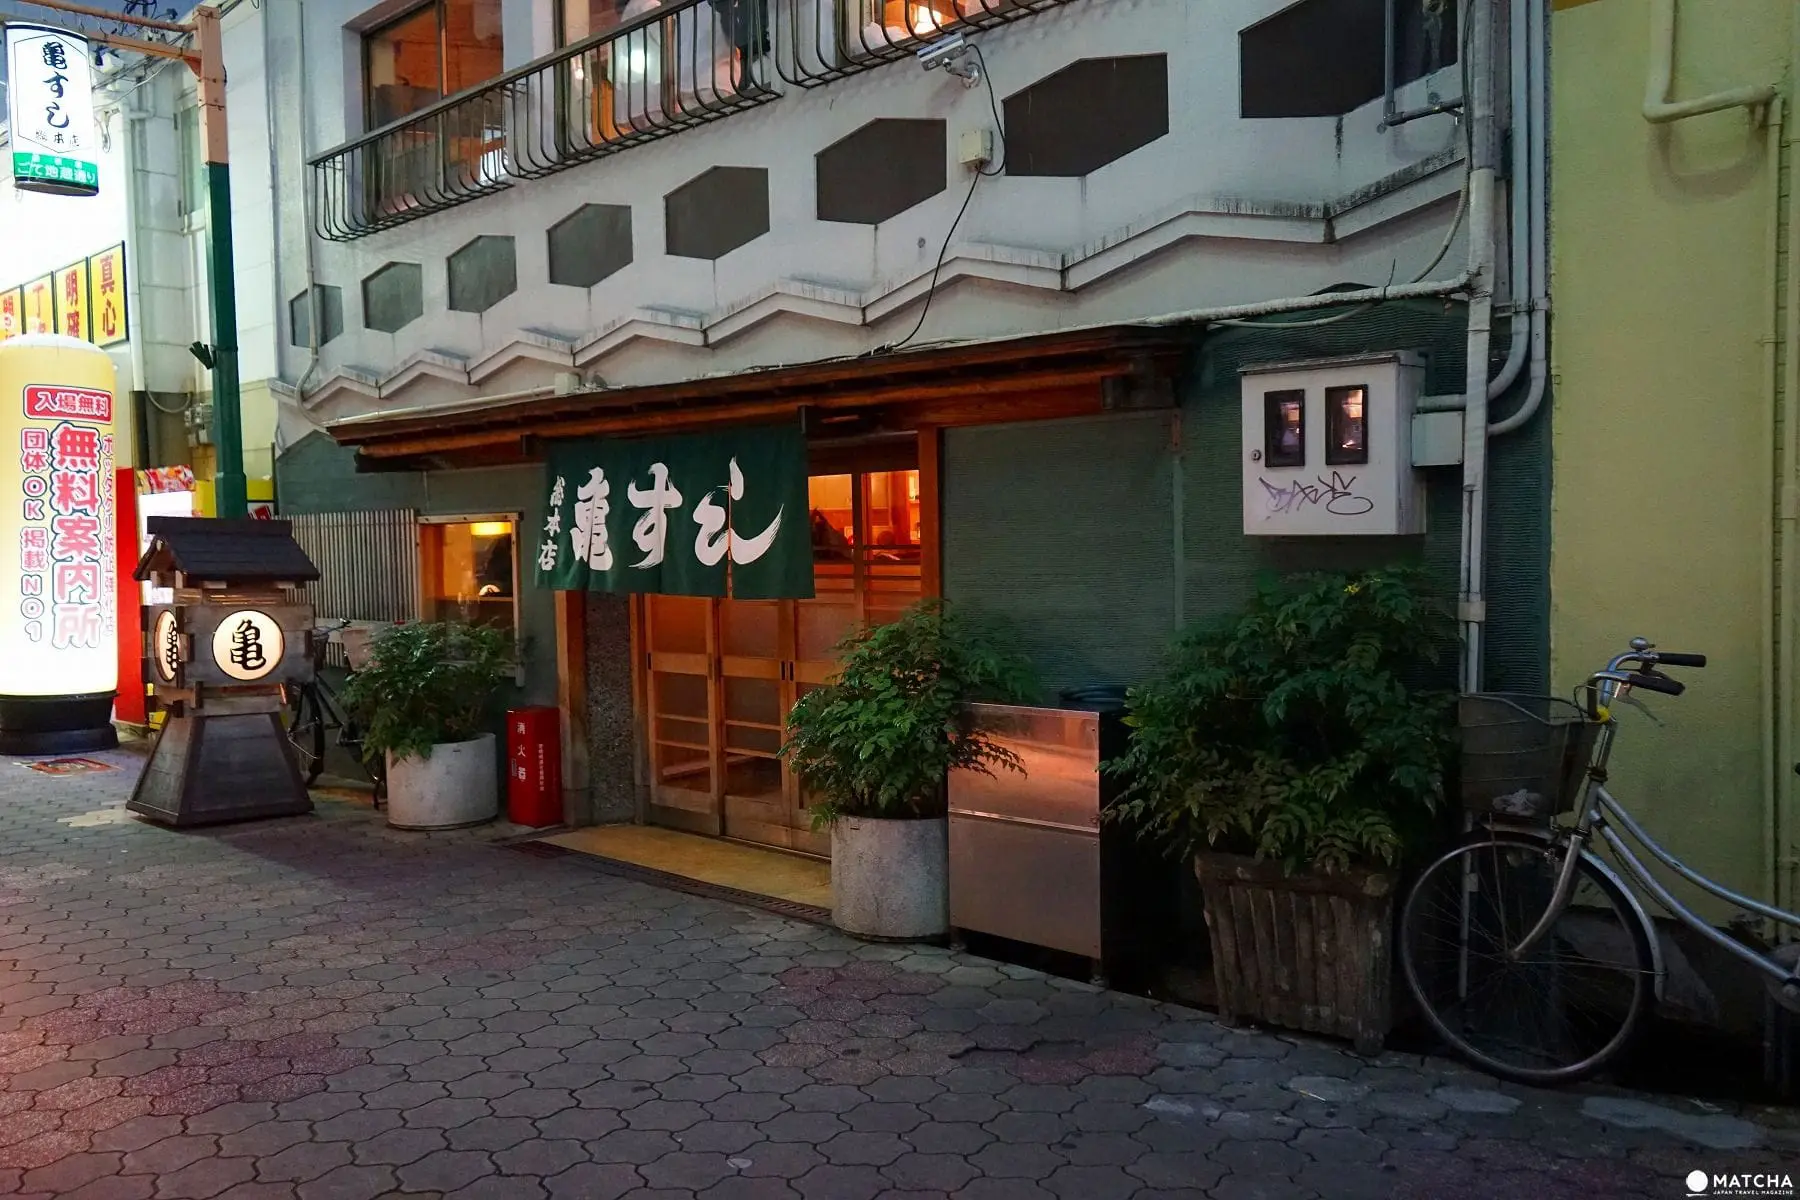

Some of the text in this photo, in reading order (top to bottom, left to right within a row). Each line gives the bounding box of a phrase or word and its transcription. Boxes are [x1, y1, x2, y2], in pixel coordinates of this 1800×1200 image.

[100, 255, 116, 337] 真心
[34, 391, 109, 417] 入場無料
[52, 423, 101, 648] 無料案内所
[231, 619, 267, 670] 亀
